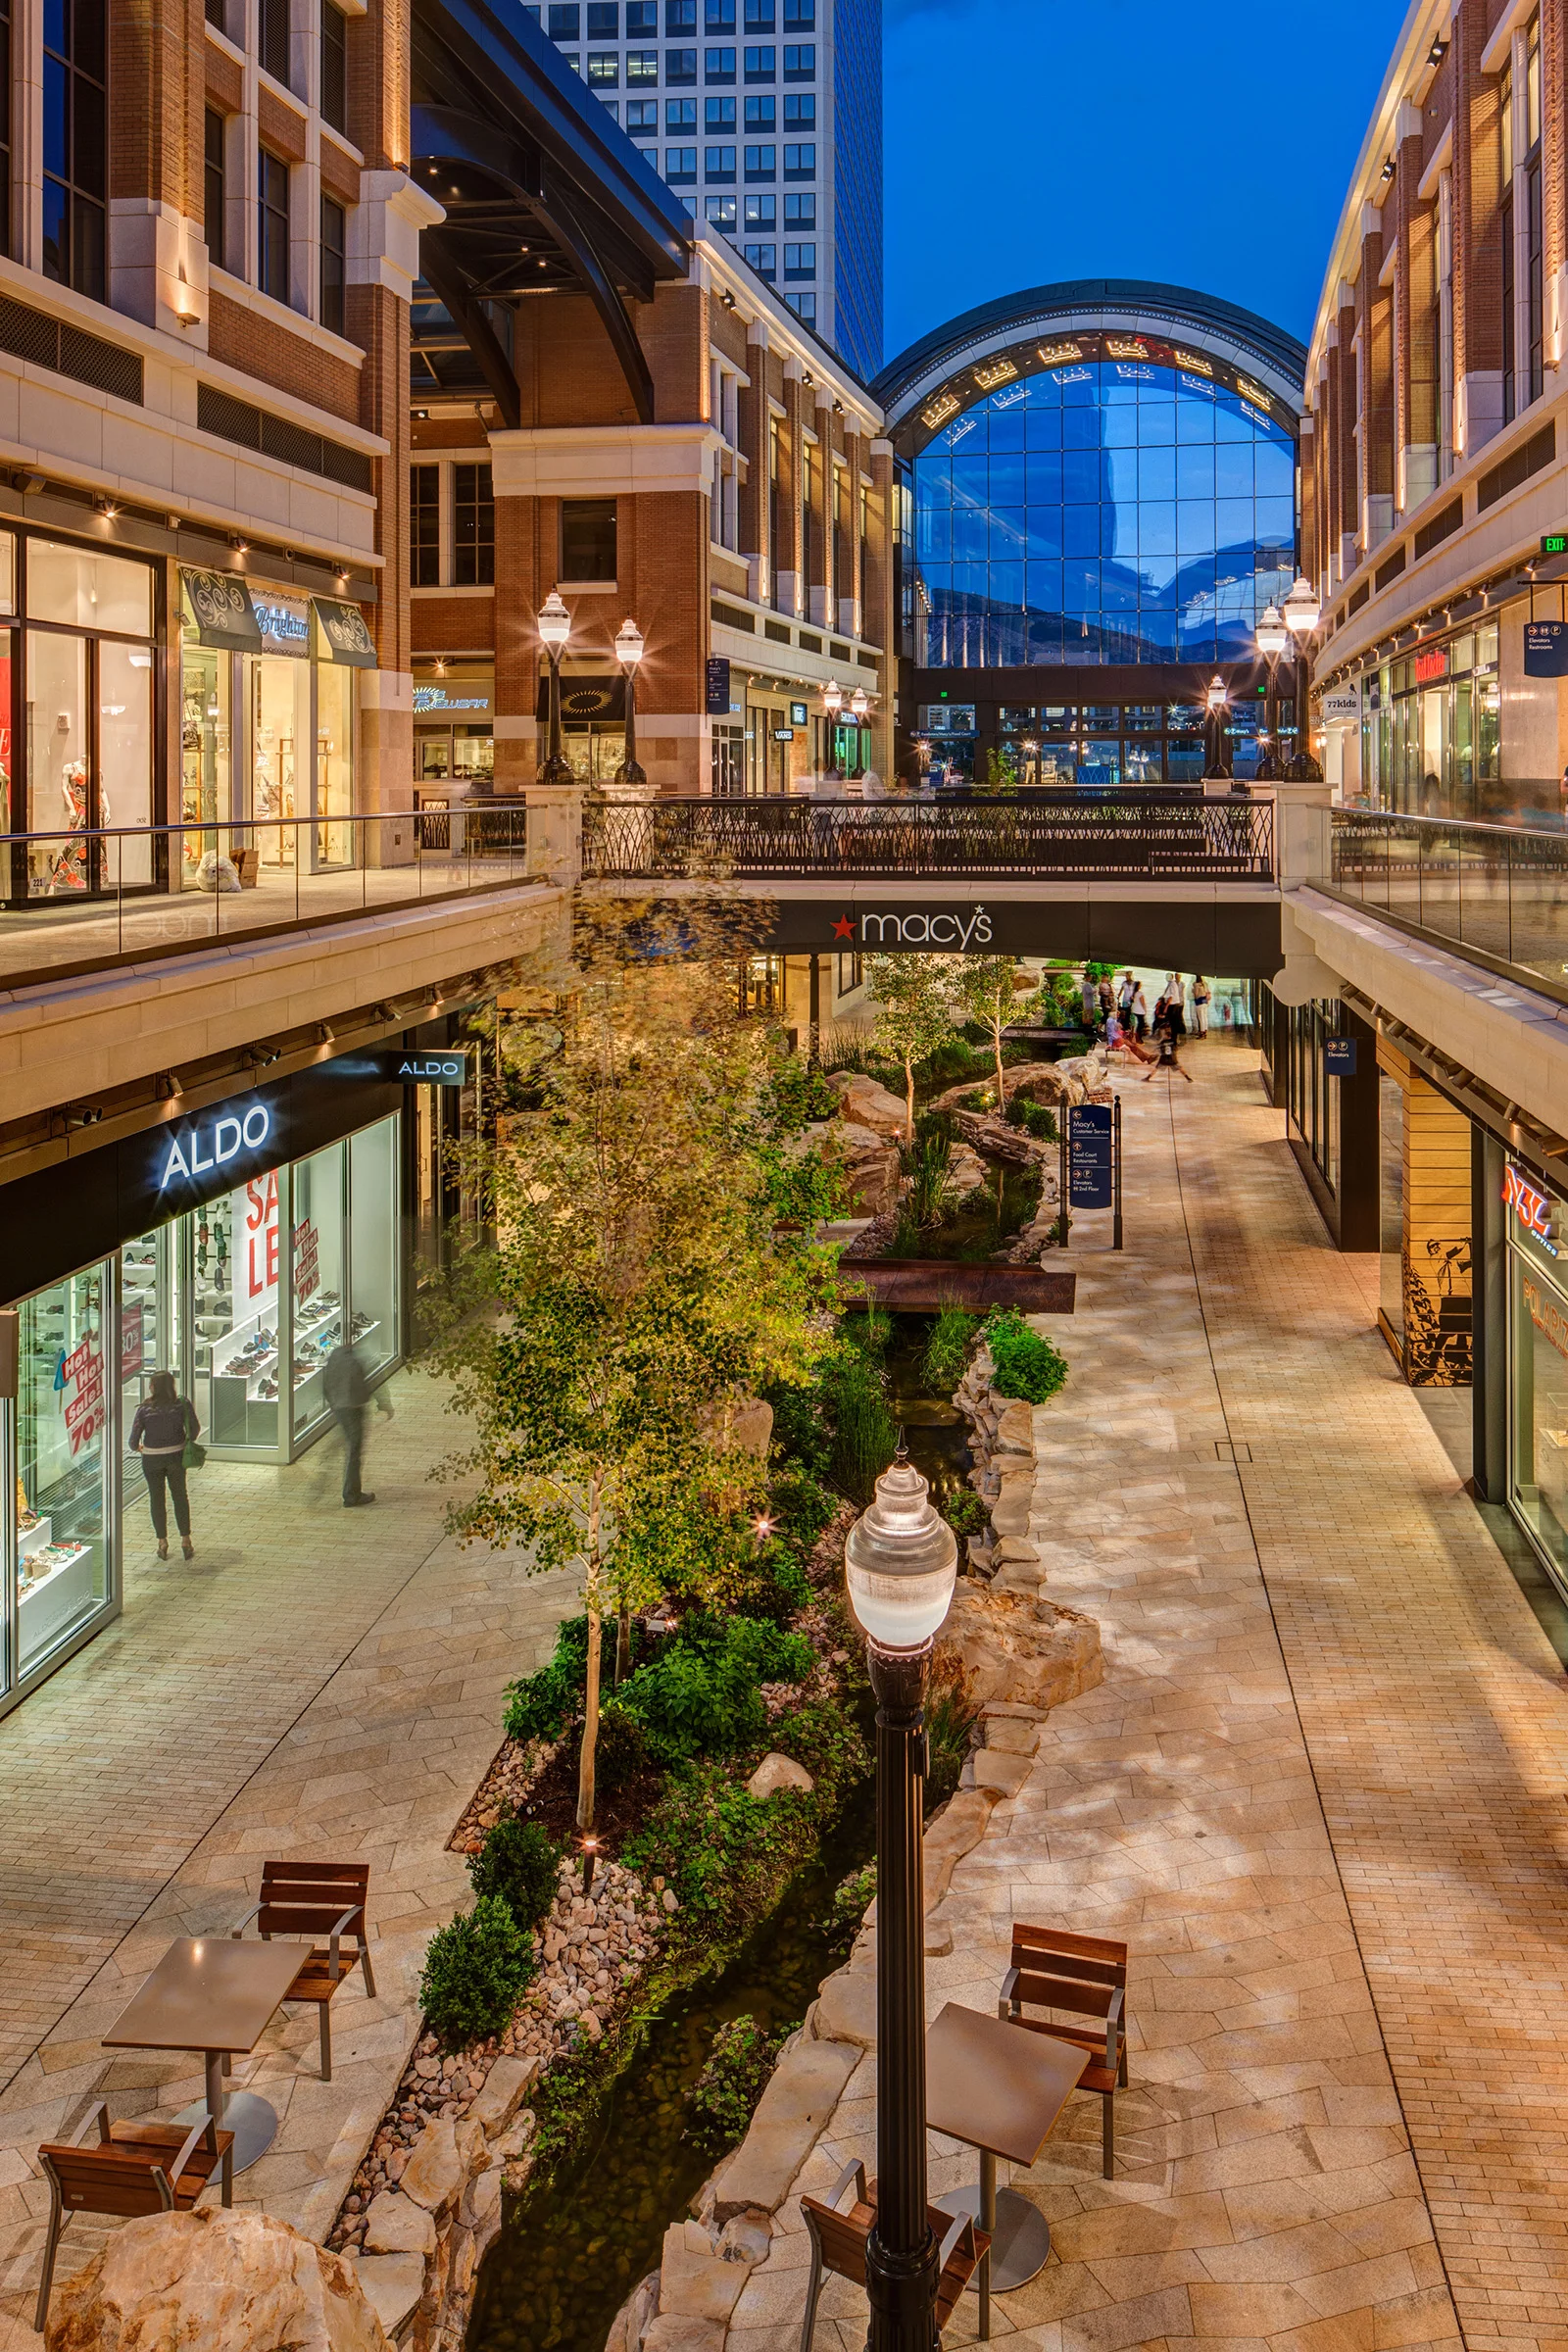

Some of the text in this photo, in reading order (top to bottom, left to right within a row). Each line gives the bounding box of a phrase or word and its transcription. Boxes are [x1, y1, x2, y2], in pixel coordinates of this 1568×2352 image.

[1545, 538, 1564, 551] EXIT
[253, 606, 309, 638] Brighton
[775, 730, 793, 740] VANS
[33, 878, 43, 887] 221
[398, 1061, 459, 1076] ALDO
[161, 1104, 270, 1189] ALDO
[295, 1223, 310, 1244] Hot
[303, 1231, 318, 1253] Hot
[1531, 1229, 1556, 1256] OPTICS
[296, 1250, 318, 1281] Sale!
[65, 1345, 88, 1378] Hot
[79, 1355, 102, 1389] Hot
[69, 1380, 101, 1425] Sale!
